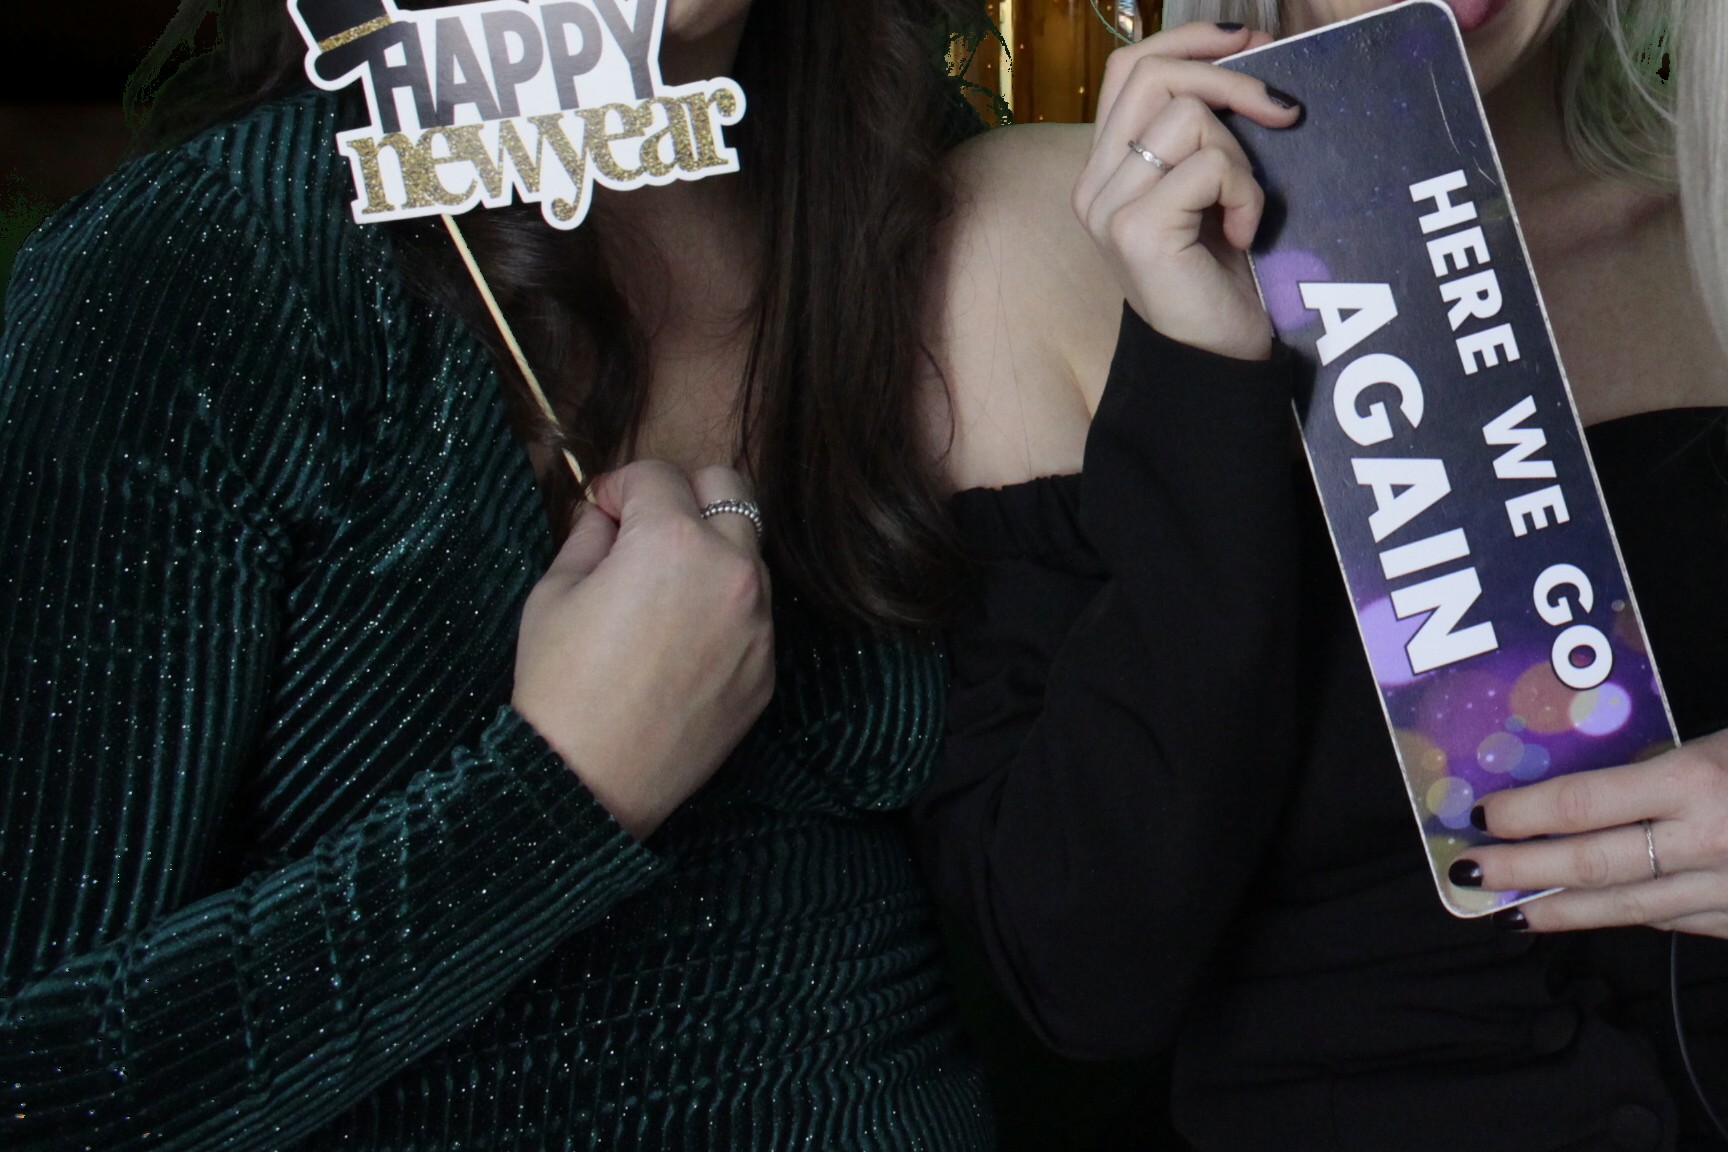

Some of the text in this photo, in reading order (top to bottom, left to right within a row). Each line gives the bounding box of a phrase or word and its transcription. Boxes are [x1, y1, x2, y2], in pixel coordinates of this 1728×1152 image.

[1298, 281, 1499, 676] AGAIN
[1408, 168, 1614, 691] HERE WE GO
